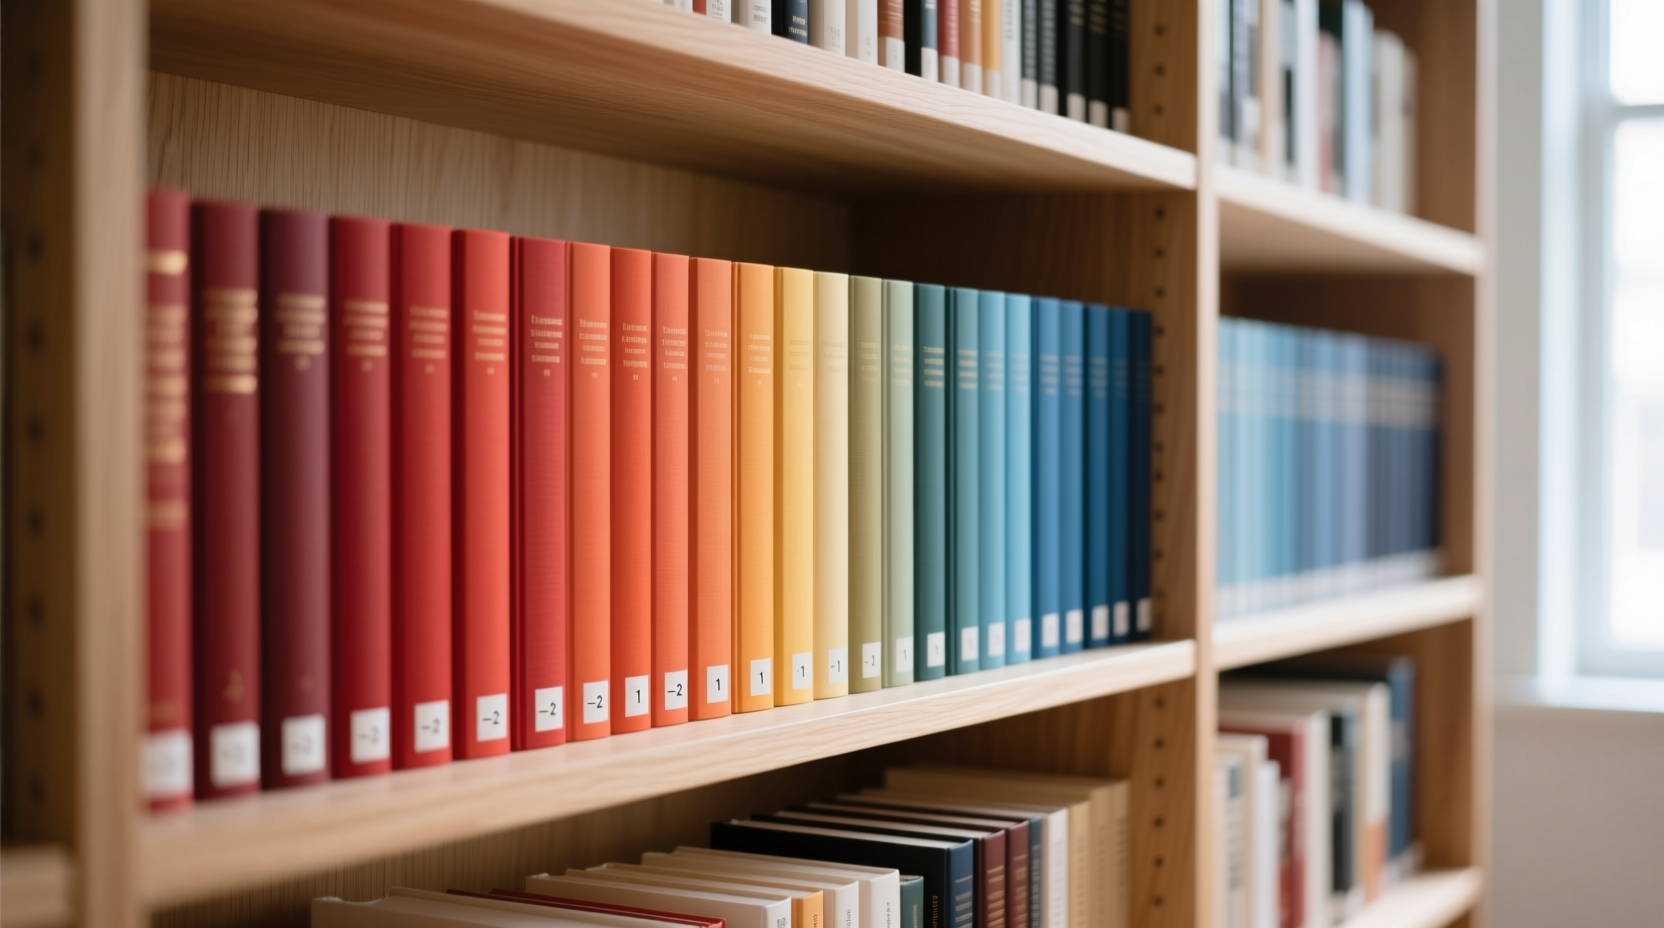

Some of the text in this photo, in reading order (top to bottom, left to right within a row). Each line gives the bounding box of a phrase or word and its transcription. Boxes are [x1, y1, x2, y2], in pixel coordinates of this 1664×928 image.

[758, 671, 765, 684] 1
[714, 678, 721, 691] 1
[635, 689, 642, 704] 1
